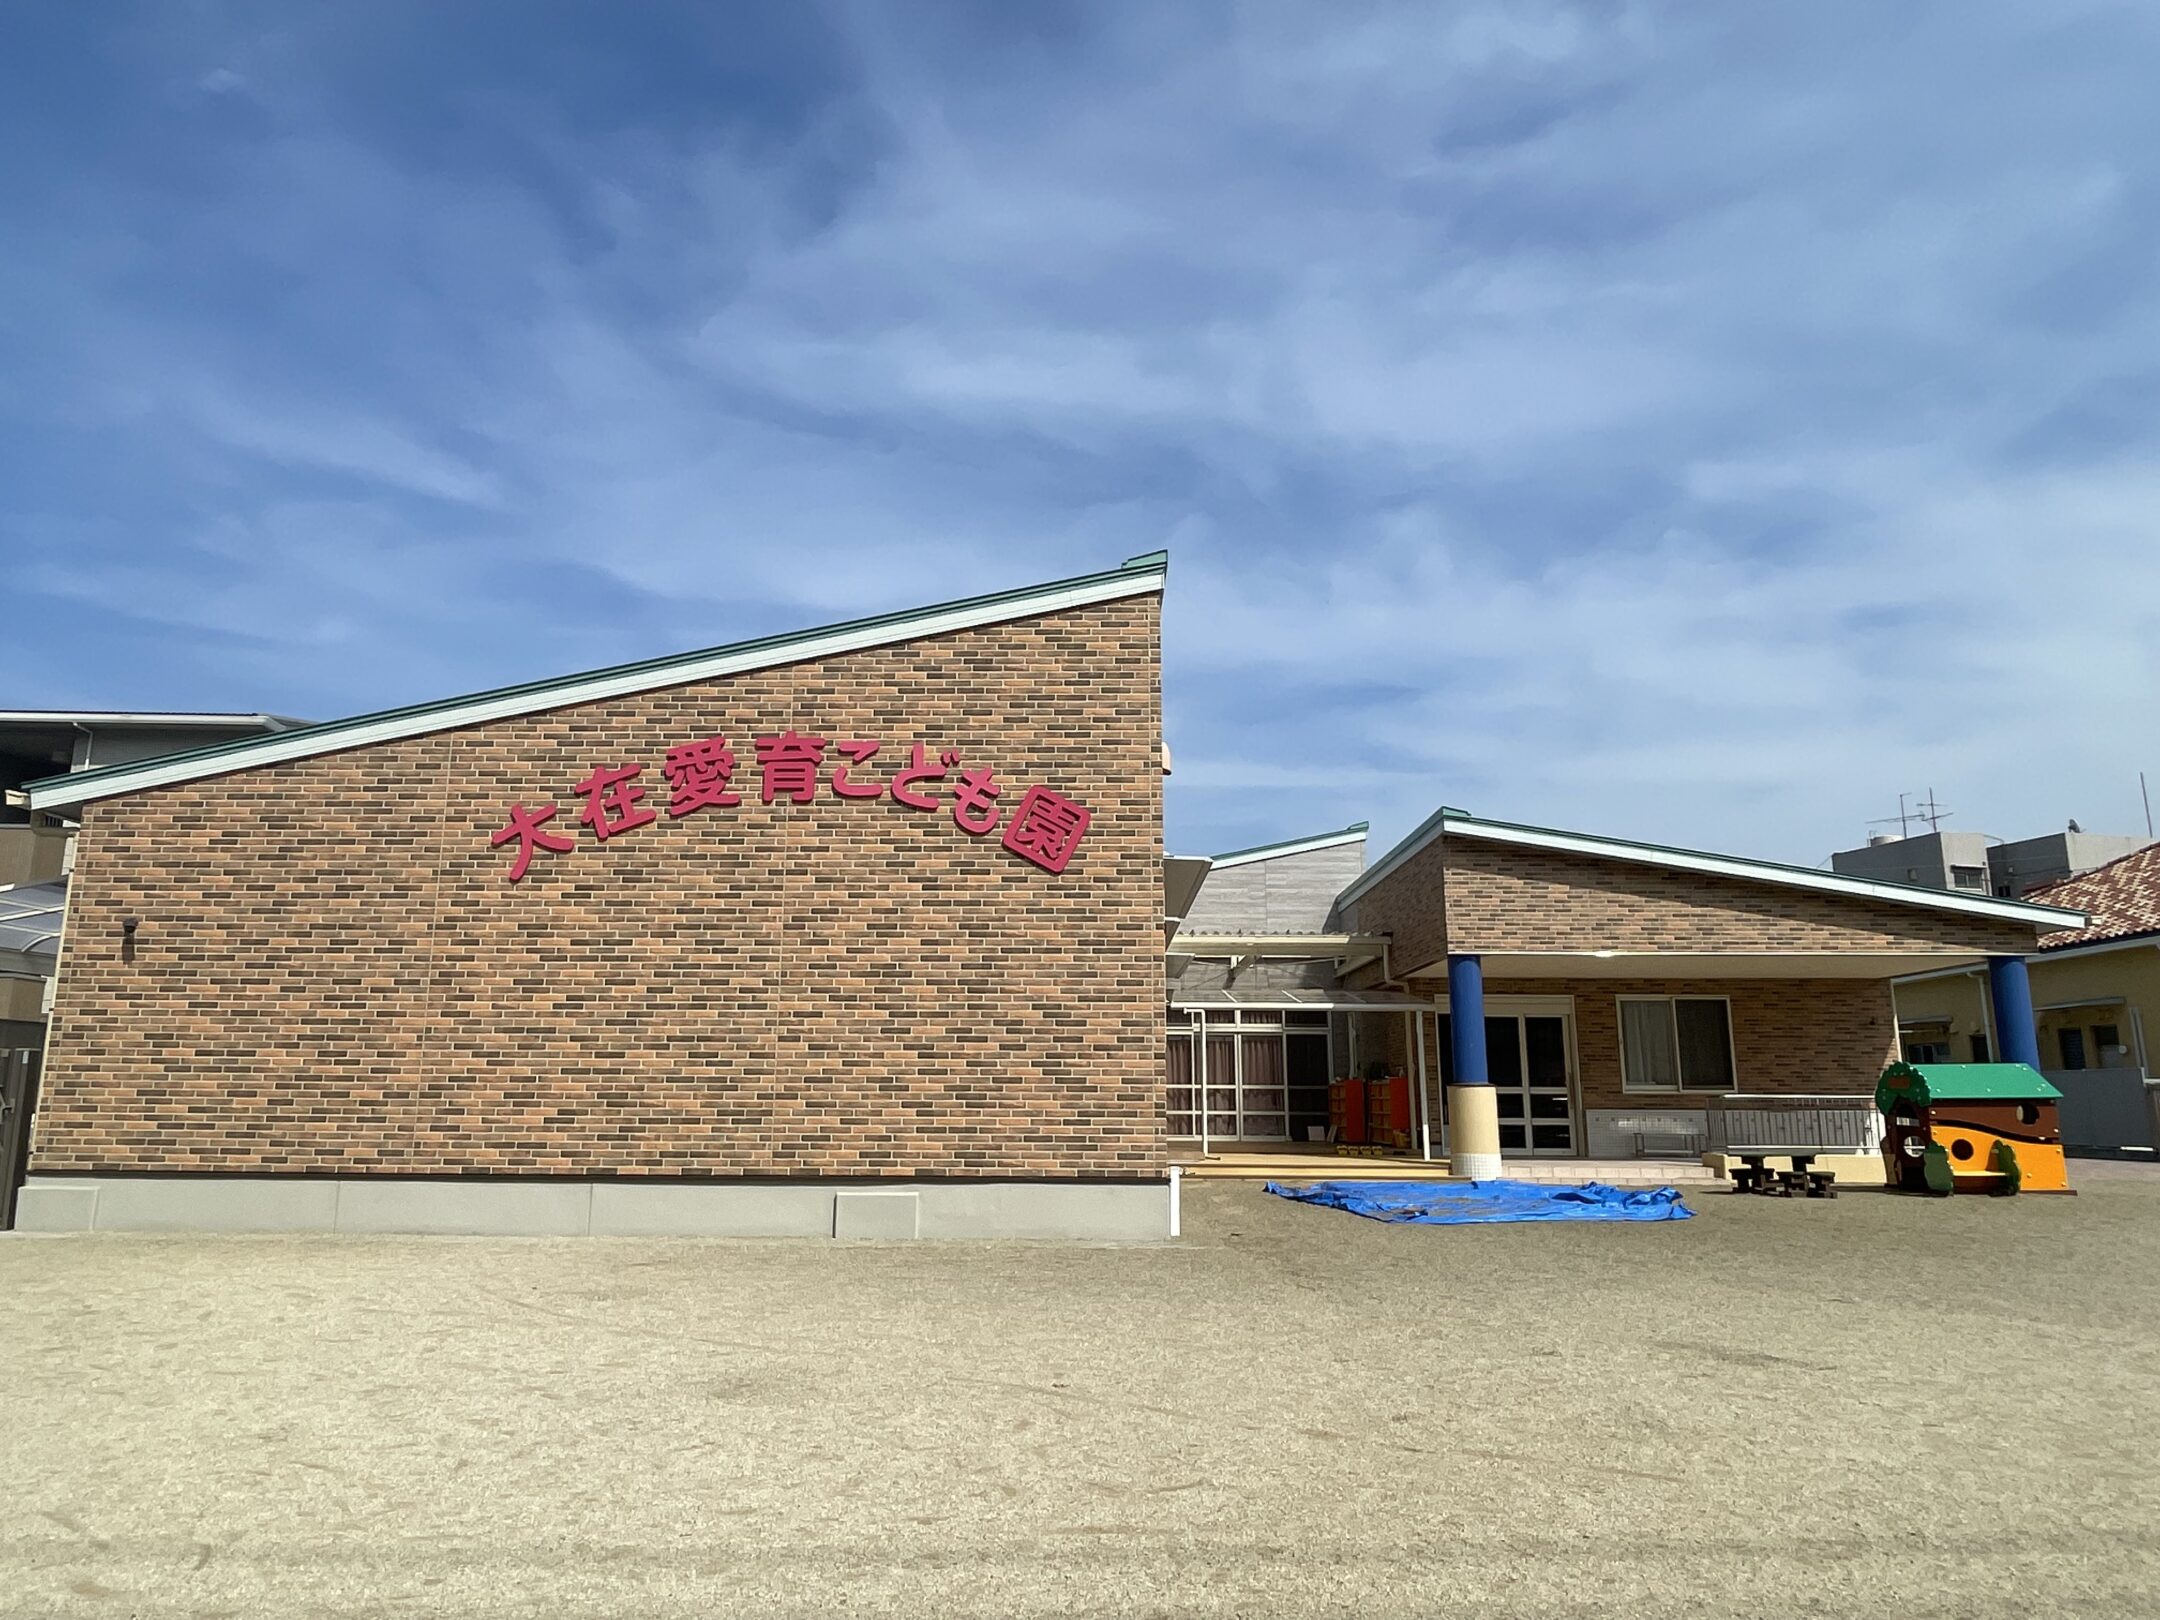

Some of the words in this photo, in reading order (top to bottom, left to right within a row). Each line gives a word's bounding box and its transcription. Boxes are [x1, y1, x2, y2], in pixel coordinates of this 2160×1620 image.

[492, 731, 1092, 881] 大在愛育こども園
